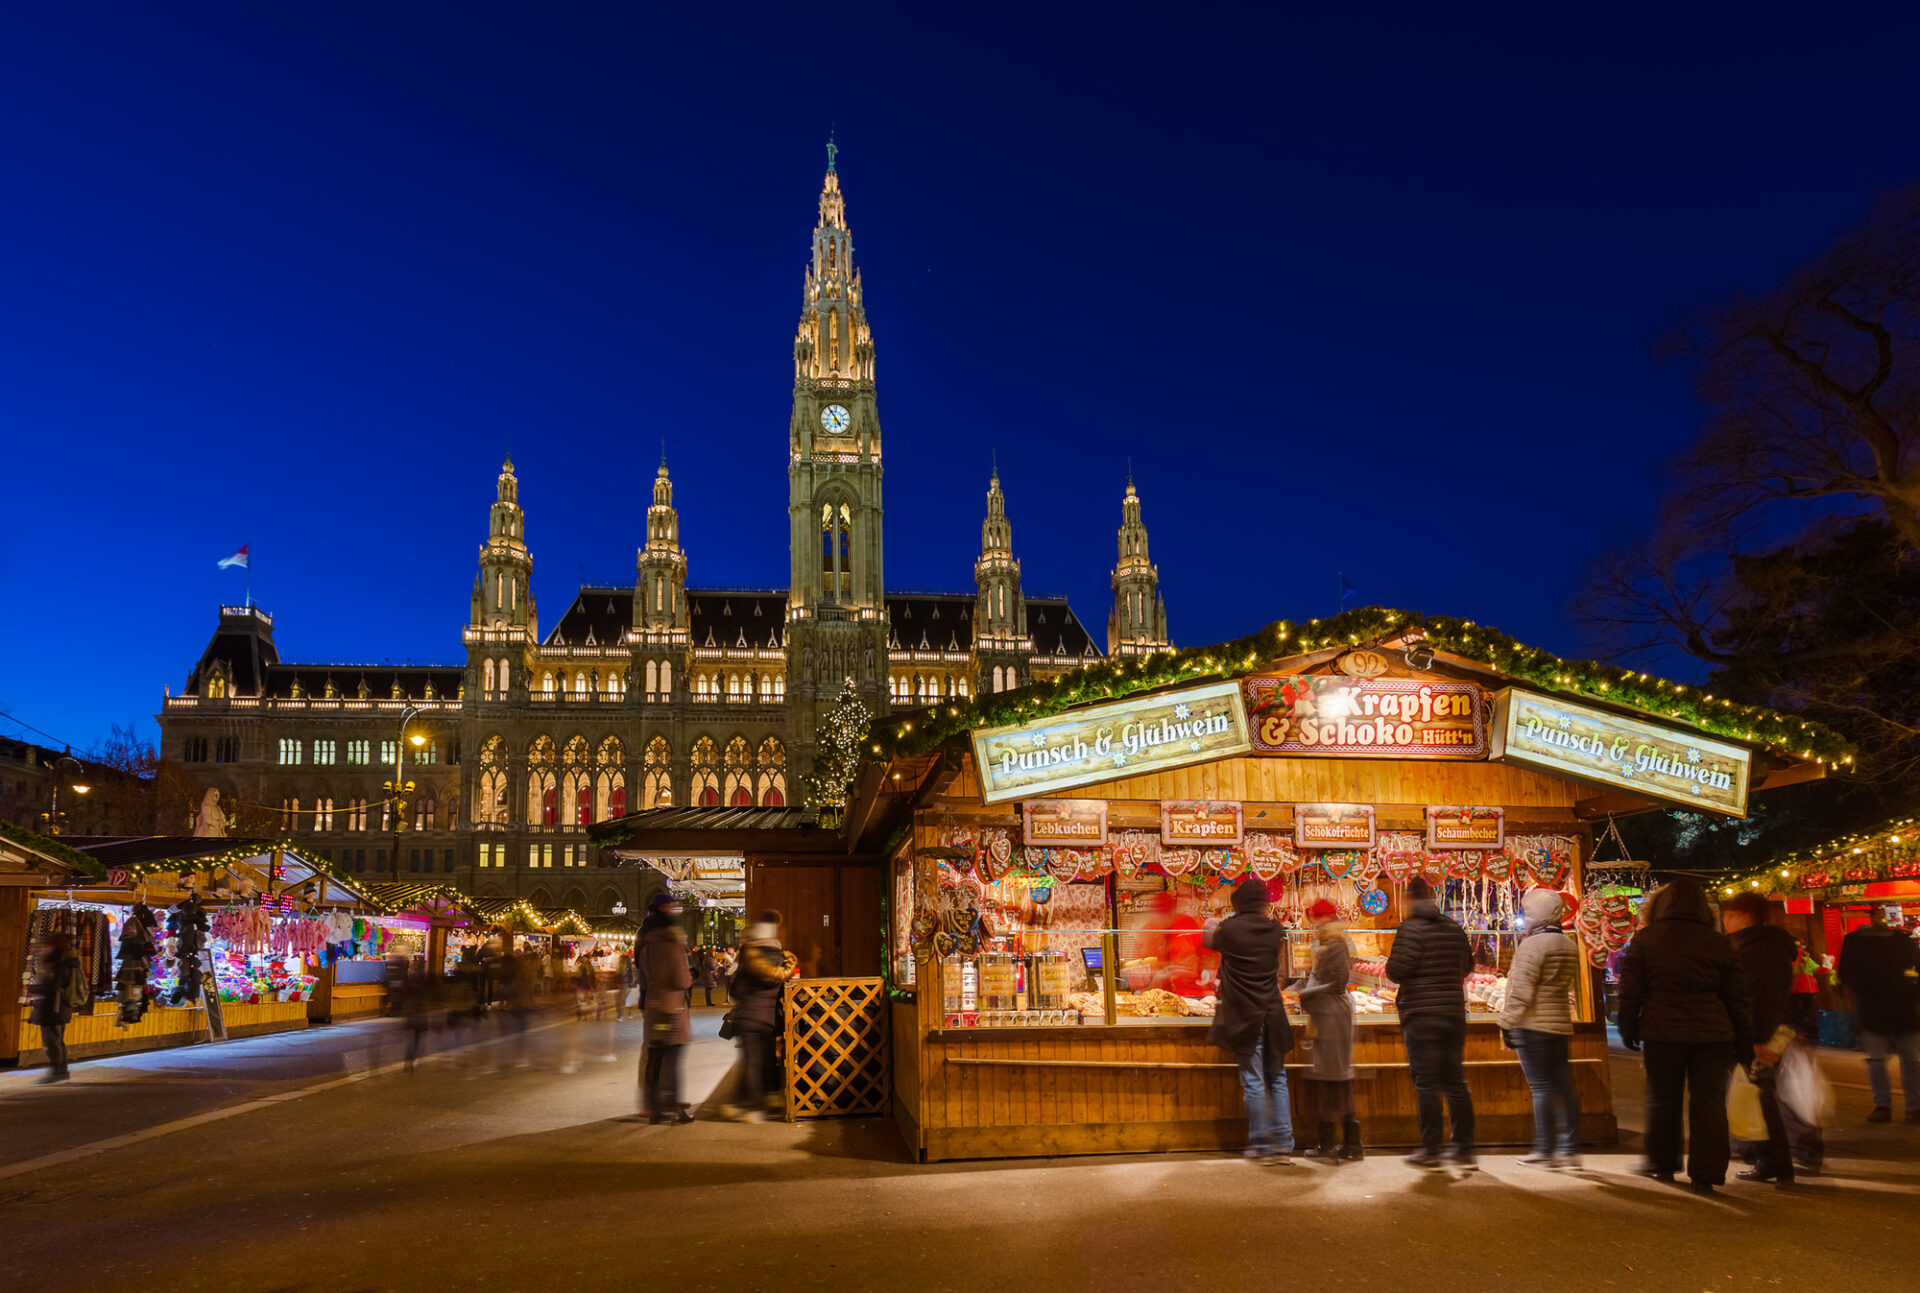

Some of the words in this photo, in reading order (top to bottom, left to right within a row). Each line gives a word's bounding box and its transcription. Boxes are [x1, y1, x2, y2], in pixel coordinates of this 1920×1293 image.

[1353, 653, 1379, 674] 92
[1337, 686, 1472, 722] Krapfen
[1260, 716, 1290, 746] &
[1299, 716, 1414, 746] Schoko
[998, 735, 1087, 774] Punsch
[1094, 728, 1114, 755] &
[1121, 710, 1230, 753] Glühwein
[1526, 714, 1604, 757] Punsch
[1610, 736, 1630, 762] &
[1635, 744, 1731, 790] Glühwein
[1033, 821, 1100, 835] Lebkuchen
[1172, 820, 1235, 837] Krapfen
[1304, 824, 1370, 839] Schokofrüchte
[1436, 826, 1498, 840] Schaumbecher
